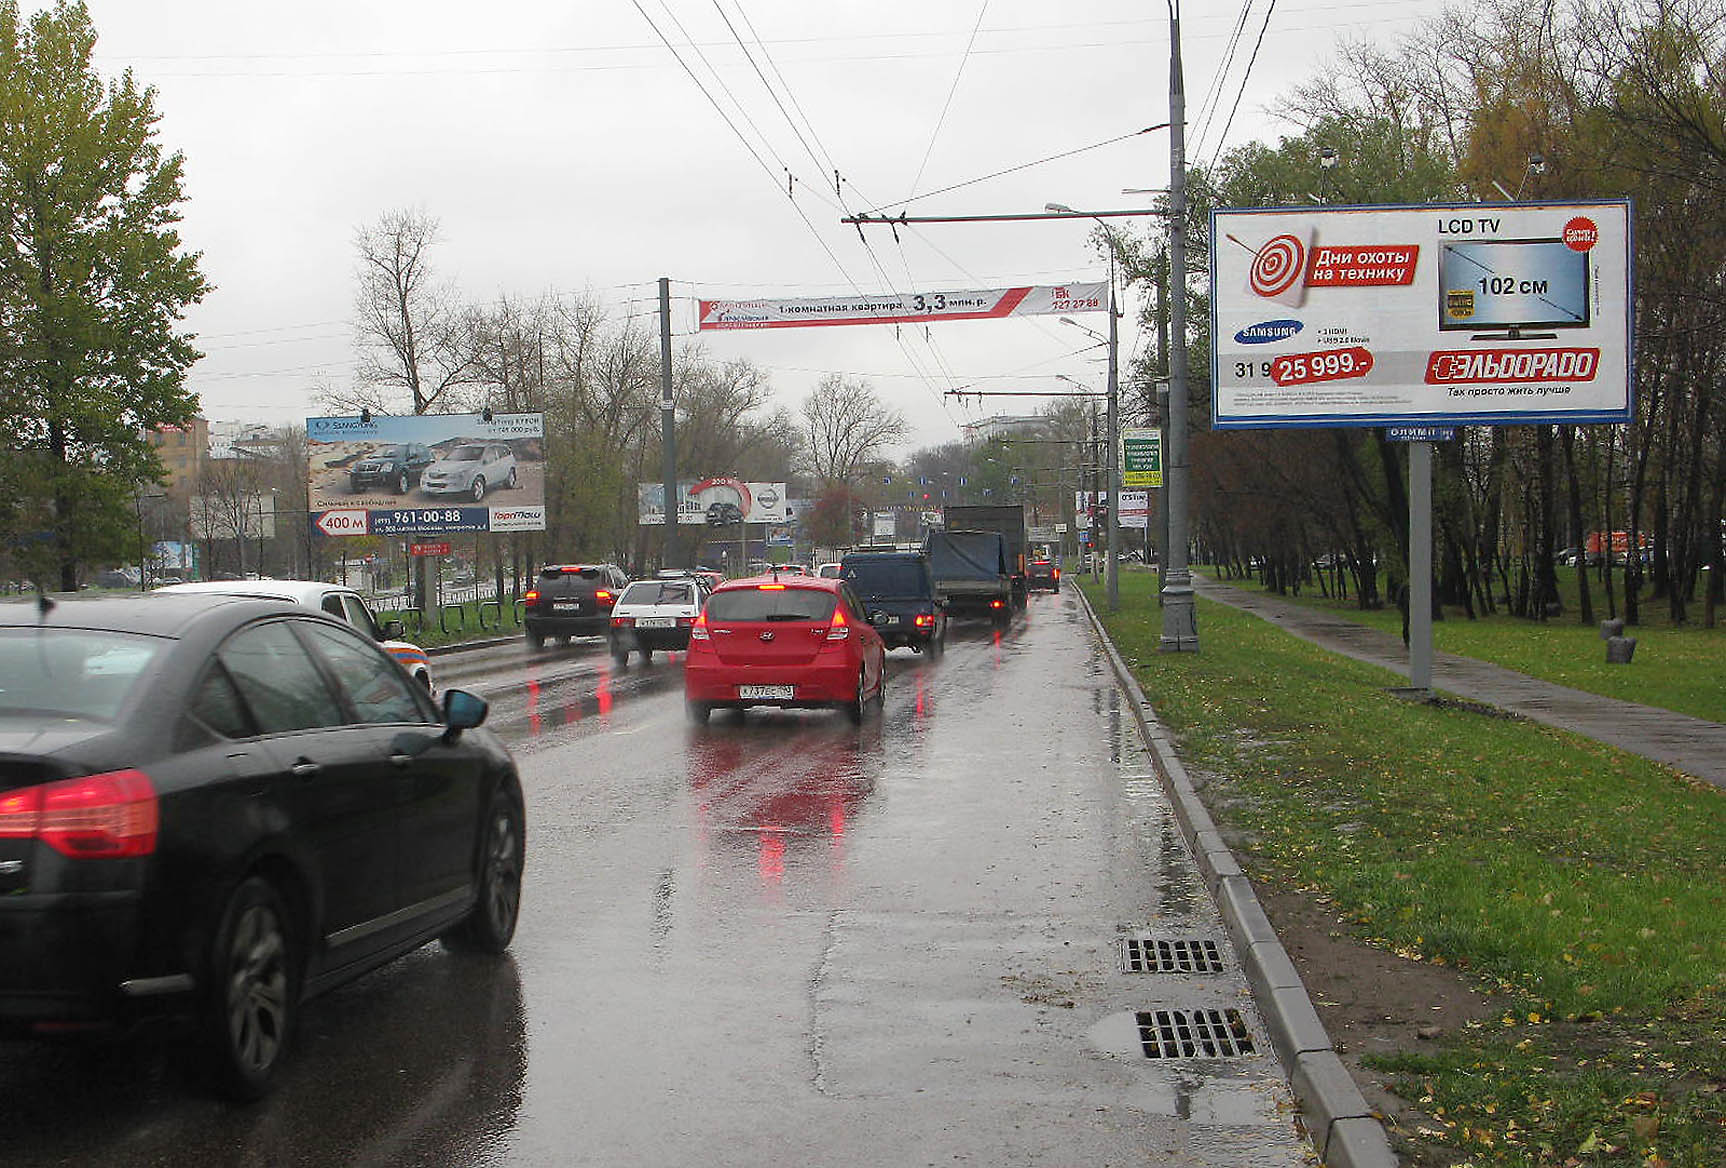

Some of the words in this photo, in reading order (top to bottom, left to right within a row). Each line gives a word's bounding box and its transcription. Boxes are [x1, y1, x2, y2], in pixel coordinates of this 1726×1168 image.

[1438, 219, 1473, 234] LCD
[1478, 218, 1501, 233] TV
[1315, 250, 1352, 267] Дни
[1357, 250, 1410, 264] охоты
[1313, 269, 1333, 280] на
[1340, 267, 1406, 281] технику
[1478, 277, 1515, 295] 102
[1519, 280, 1548, 295] см
[779, 303, 848, 314] 1-комнатная
[851, 302, 902, 315] квартира
[913, 294, 946, 313] 3,3
[1242, 326, 1298, 338] SAMSUNG
[1234, 362, 1254, 378] 31
[1279, 358, 1307, 382] 25
[1447, 387, 1466, 397] Так
[1467, 387, 1505, 398] просто
[1507, 386, 1534, 396] жить
[1536, 386, 1572, 398] лучше
[325, 516, 350, 529] 400
[352, 519, 364, 528] м
[394, 509, 461, 523] 961-00-88
